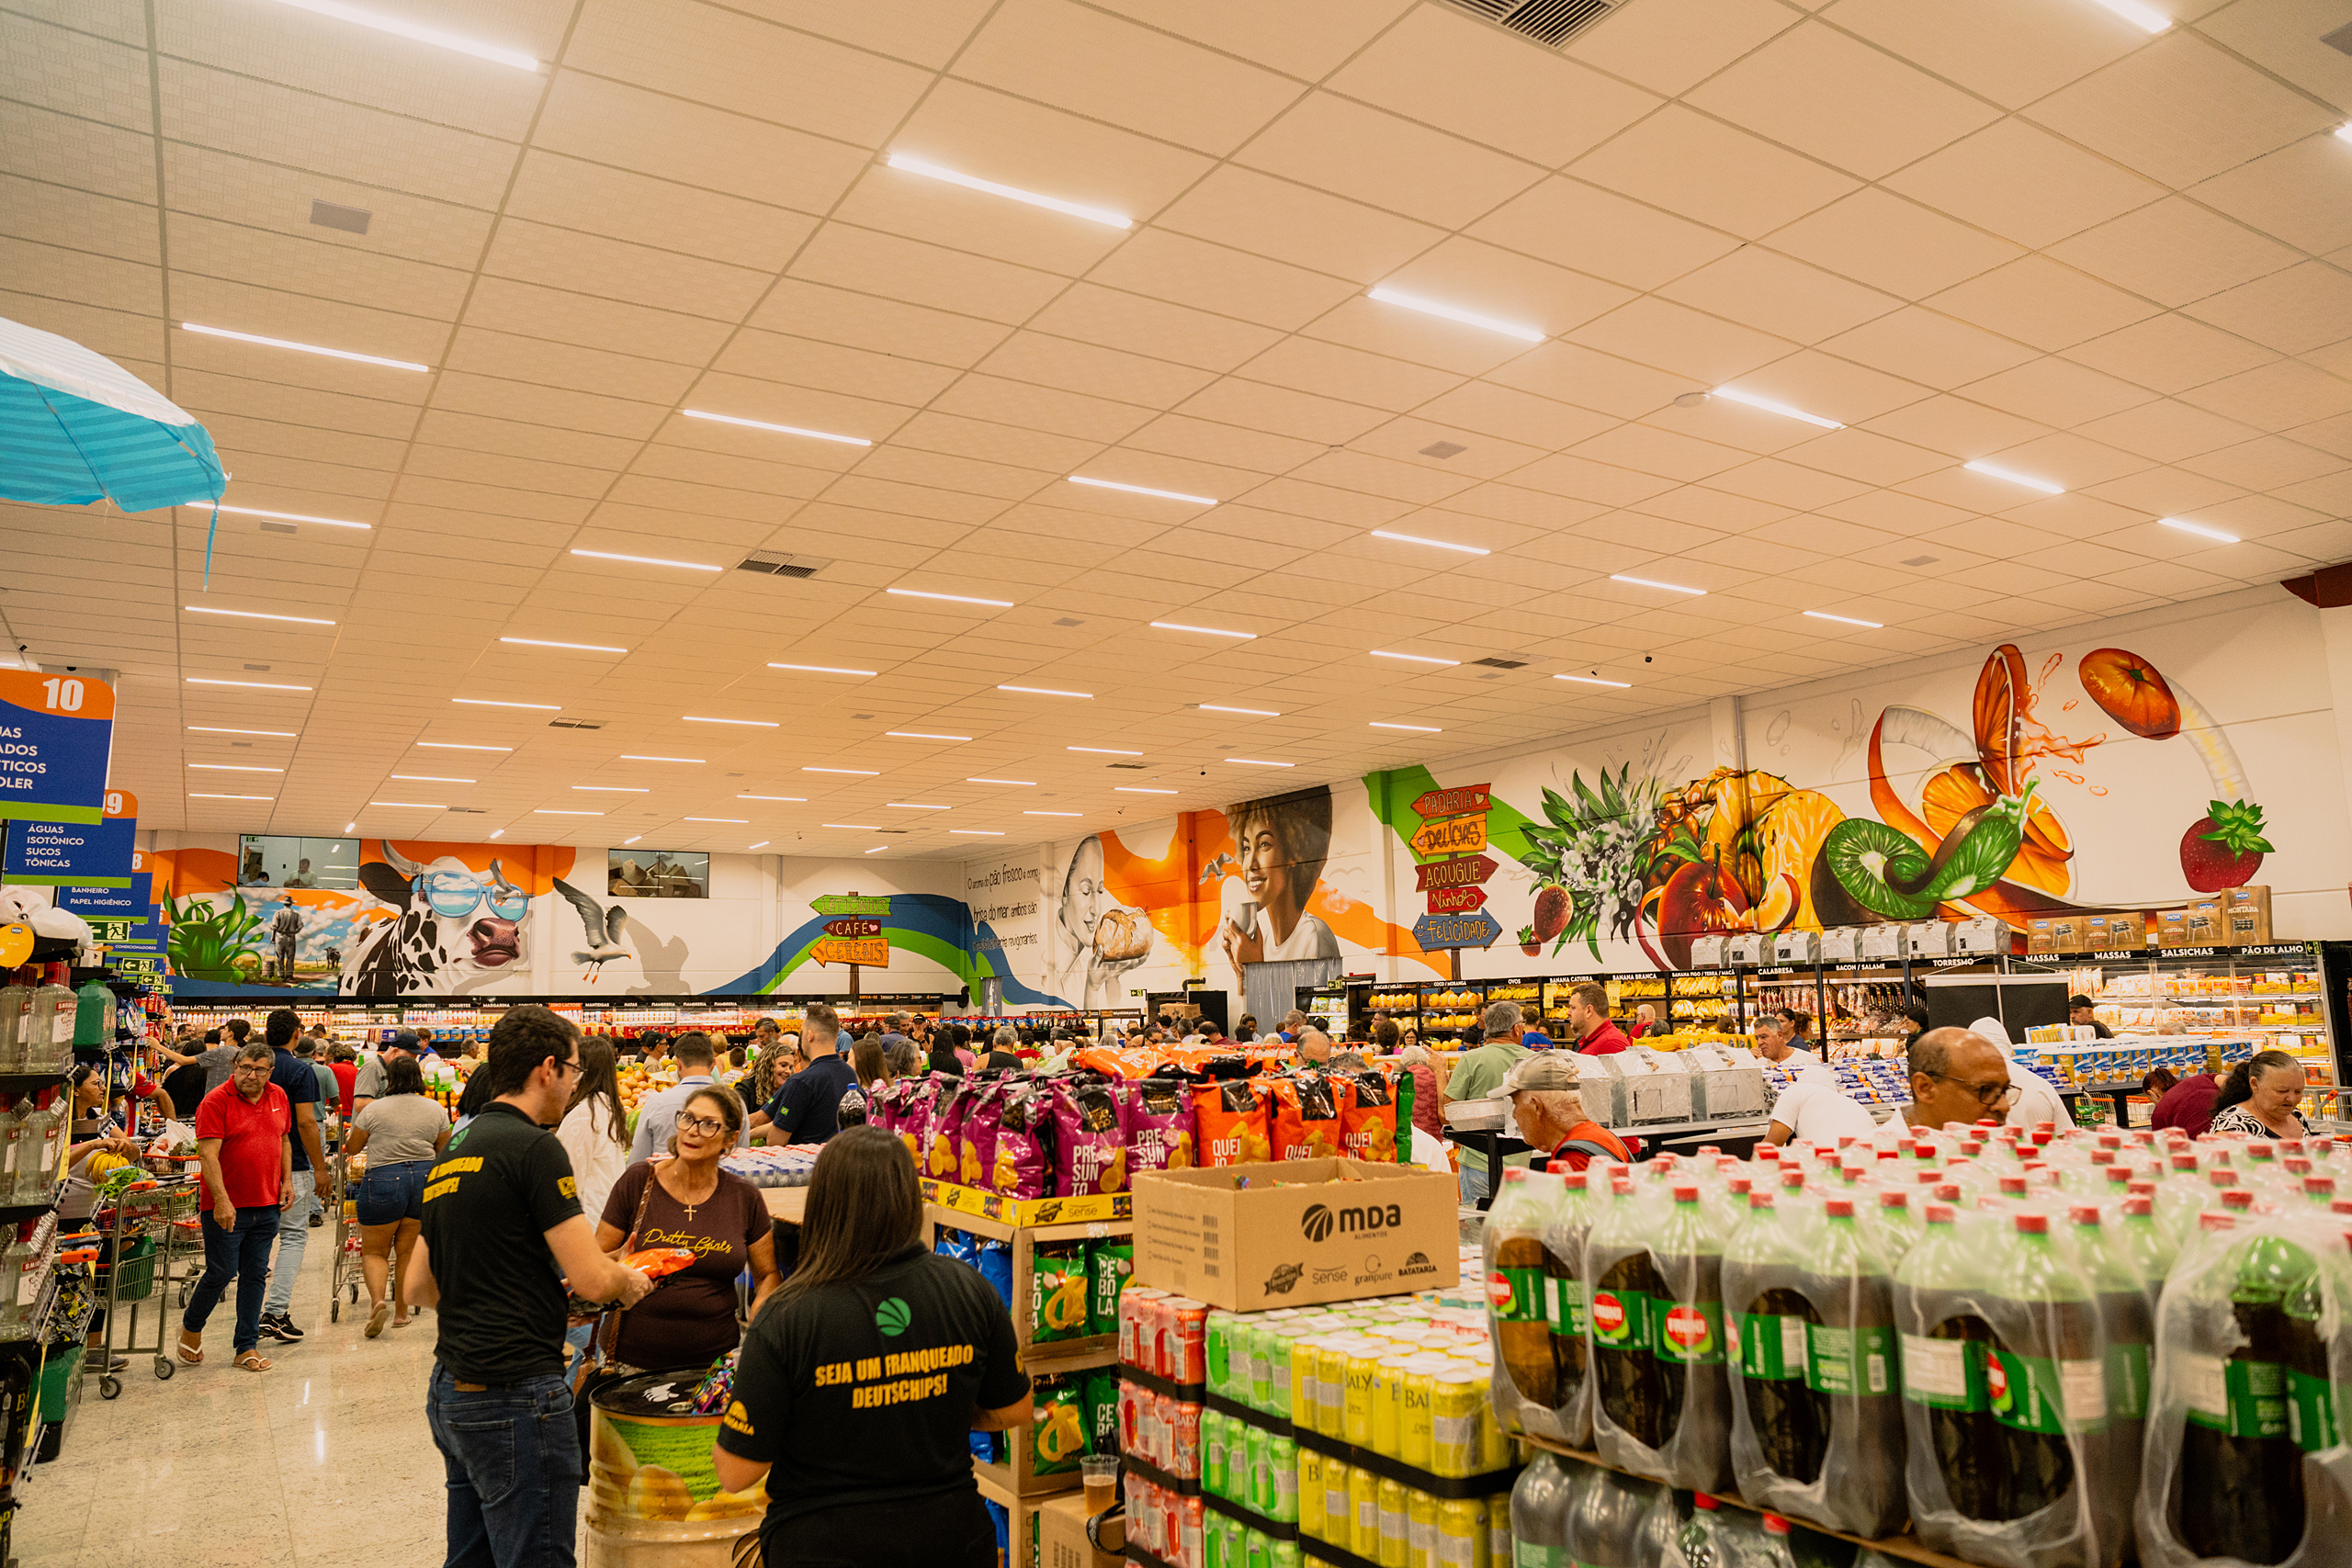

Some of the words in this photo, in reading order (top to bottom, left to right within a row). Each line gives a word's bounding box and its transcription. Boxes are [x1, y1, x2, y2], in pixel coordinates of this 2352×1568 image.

[42, 678, 85, 711] 10
[103, 793, 123, 814] 9
[1424, 790, 1472, 816] PADARIA
[28, 823, 64, 834] ÁGUAS
[27, 836, 85, 846] ISOTÔNICO
[26, 847, 62, 856] SUCOS
[25, 858, 71, 868] TÔNICAS
[989, 870, 1001, 893] pão
[1002, 863, 1023, 885] fresco
[1425, 861, 1481, 887] AÇOUGUE
[71, 886, 109, 895] BANHEIRO
[94, 898, 132, 907] HIGIÊNICO
[822, 897, 887, 913] LATICÍNIOS
[1028, 902, 1038, 915] são
[835, 920, 868, 935] CAFÉ
[1427, 919, 1489, 942] FELICIDADE
[825, 942, 884, 963] CEREAIS
[2025, 953, 2060, 963] MASSAS
[2095, 951, 2132, 960] MASSAS
[2161, 948, 2214, 957] SALSICHAS
[2242, 945, 2262, 955] PÃO
[2277, 945, 2304, 953] ALHO
[1932, 958, 1974, 967] TORRESMO
[1758, 967, 1794, 976] CALABRESA
[1136, 1128, 1164, 1146] PRE
[1345, 1132, 1373, 1148] QUEI
[1073, 1145, 1098, 1164] PRE
[1139, 1145, 1166, 1165] SUN
[1213, 1138, 1240, 1156] QUEI
[1285, 1145, 1313, 1161] QUEI
[1072, 1163, 1100, 1182] SUN
[1069, 1205, 1098, 1217] sense
[642, 1228, 696, 1249] Pretty
[694, 1236, 733, 1258] Girls
[1354, 1231, 1388, 1240] ALIMENTOS
[1098, 1259, 1115, 1279] CE
[1312, 1269, 1348, 1285] sense
[1398, 1264, 1438, 1277] BATATARIA
[1033, 1272, 1042, 1292] E
[1354, 1272, 1393, 1287] granpure
[1098, 1279, 1116, 1297] BO
[1097, 1297, 1114, 1315] LA
[815, 1361, 854, 1388] SEJA
[856, 1356, 882, 1382] UM
[885, 1344, 974, 1378] FRANQUEADO
[852, 1373, 948, 1409] DEUTSCHIPS!
[1097, 1404, 1114, 1423] CE
[1174, 1412, 1198, 1427] BALY
